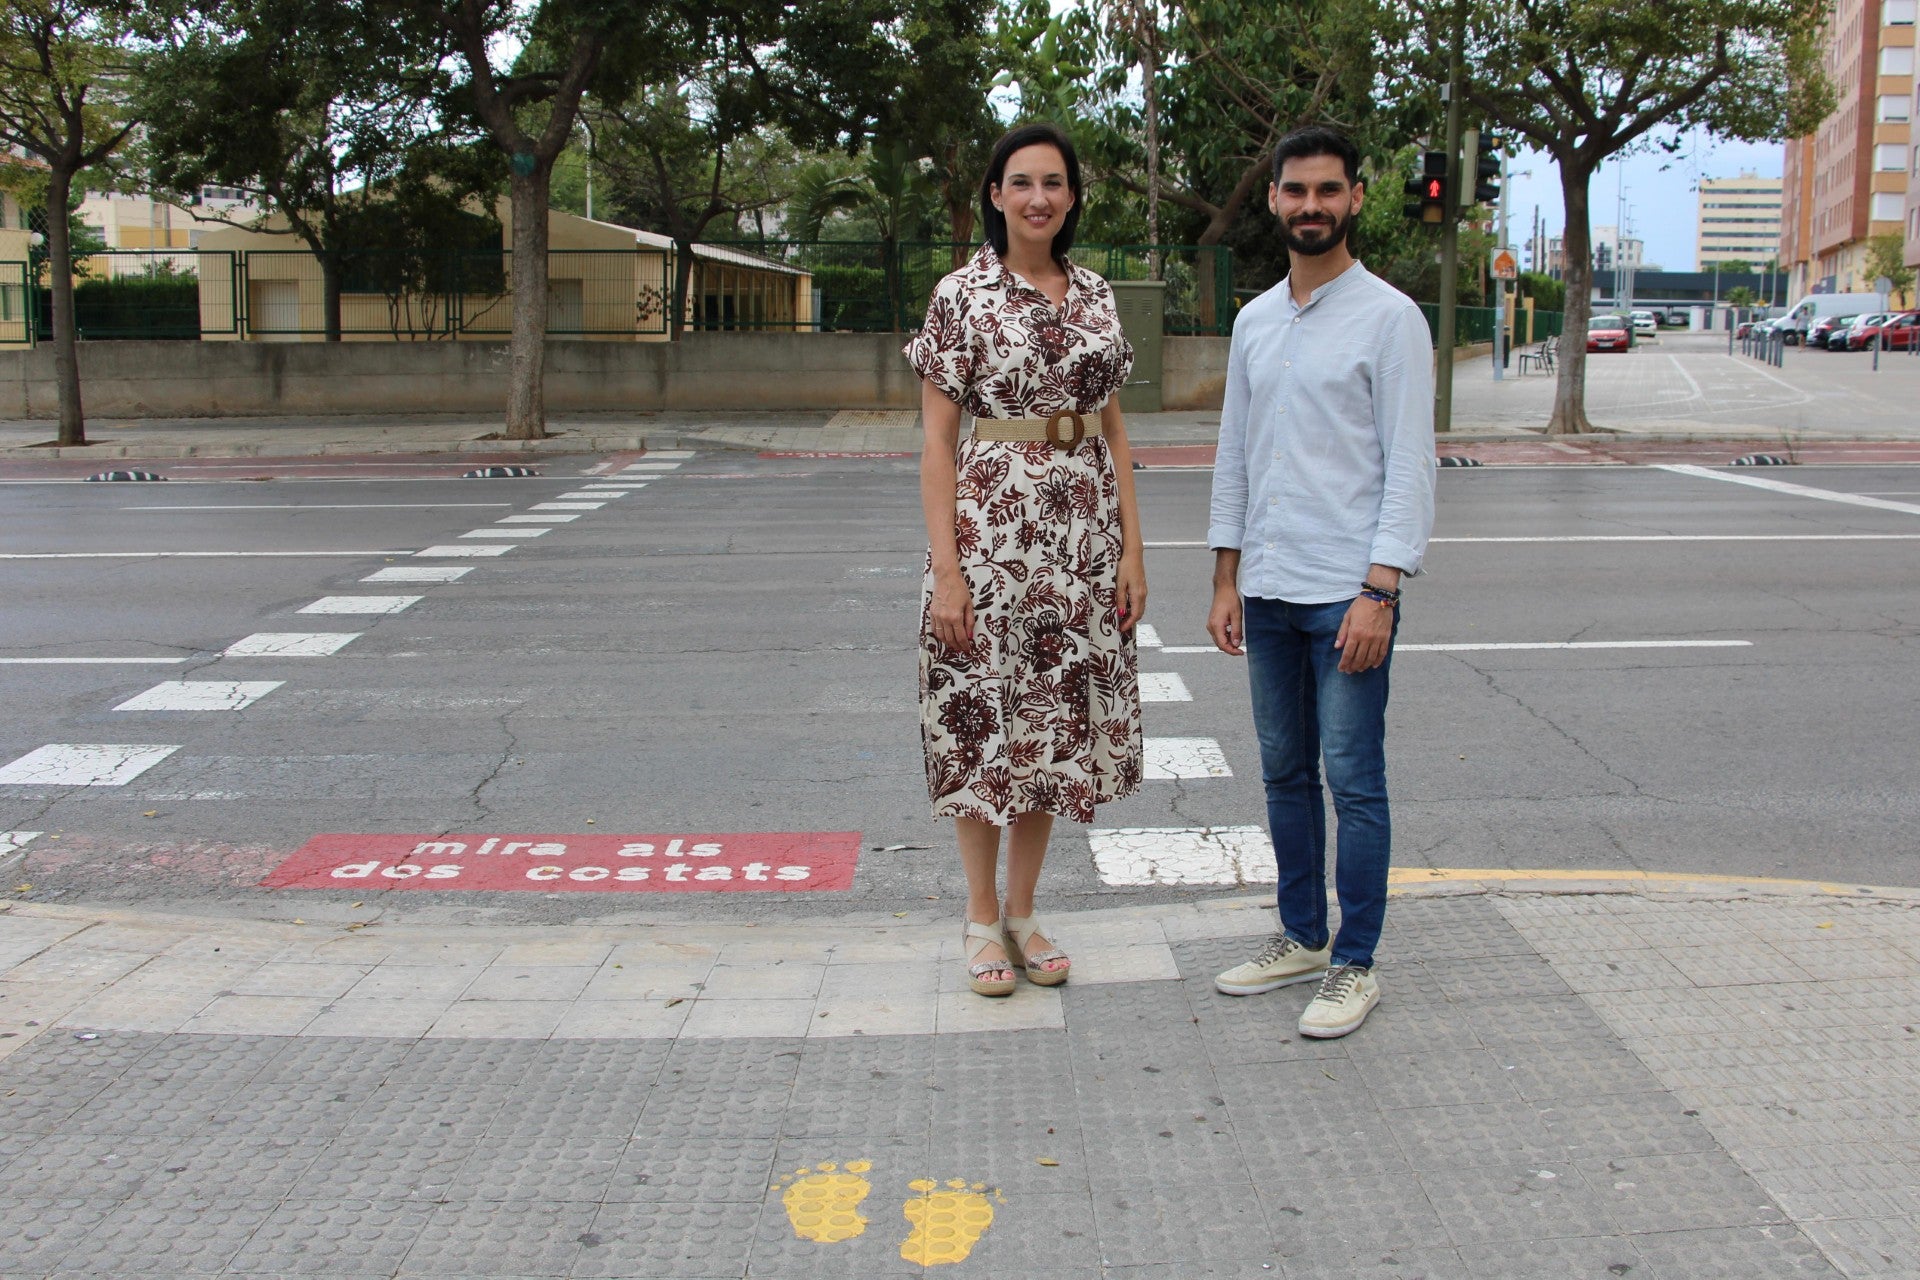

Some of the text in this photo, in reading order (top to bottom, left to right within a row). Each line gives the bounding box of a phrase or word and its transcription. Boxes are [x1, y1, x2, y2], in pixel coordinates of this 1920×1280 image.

[409, 837, 723, 857] mira als
[330, 861, 811, 882] dos costats
